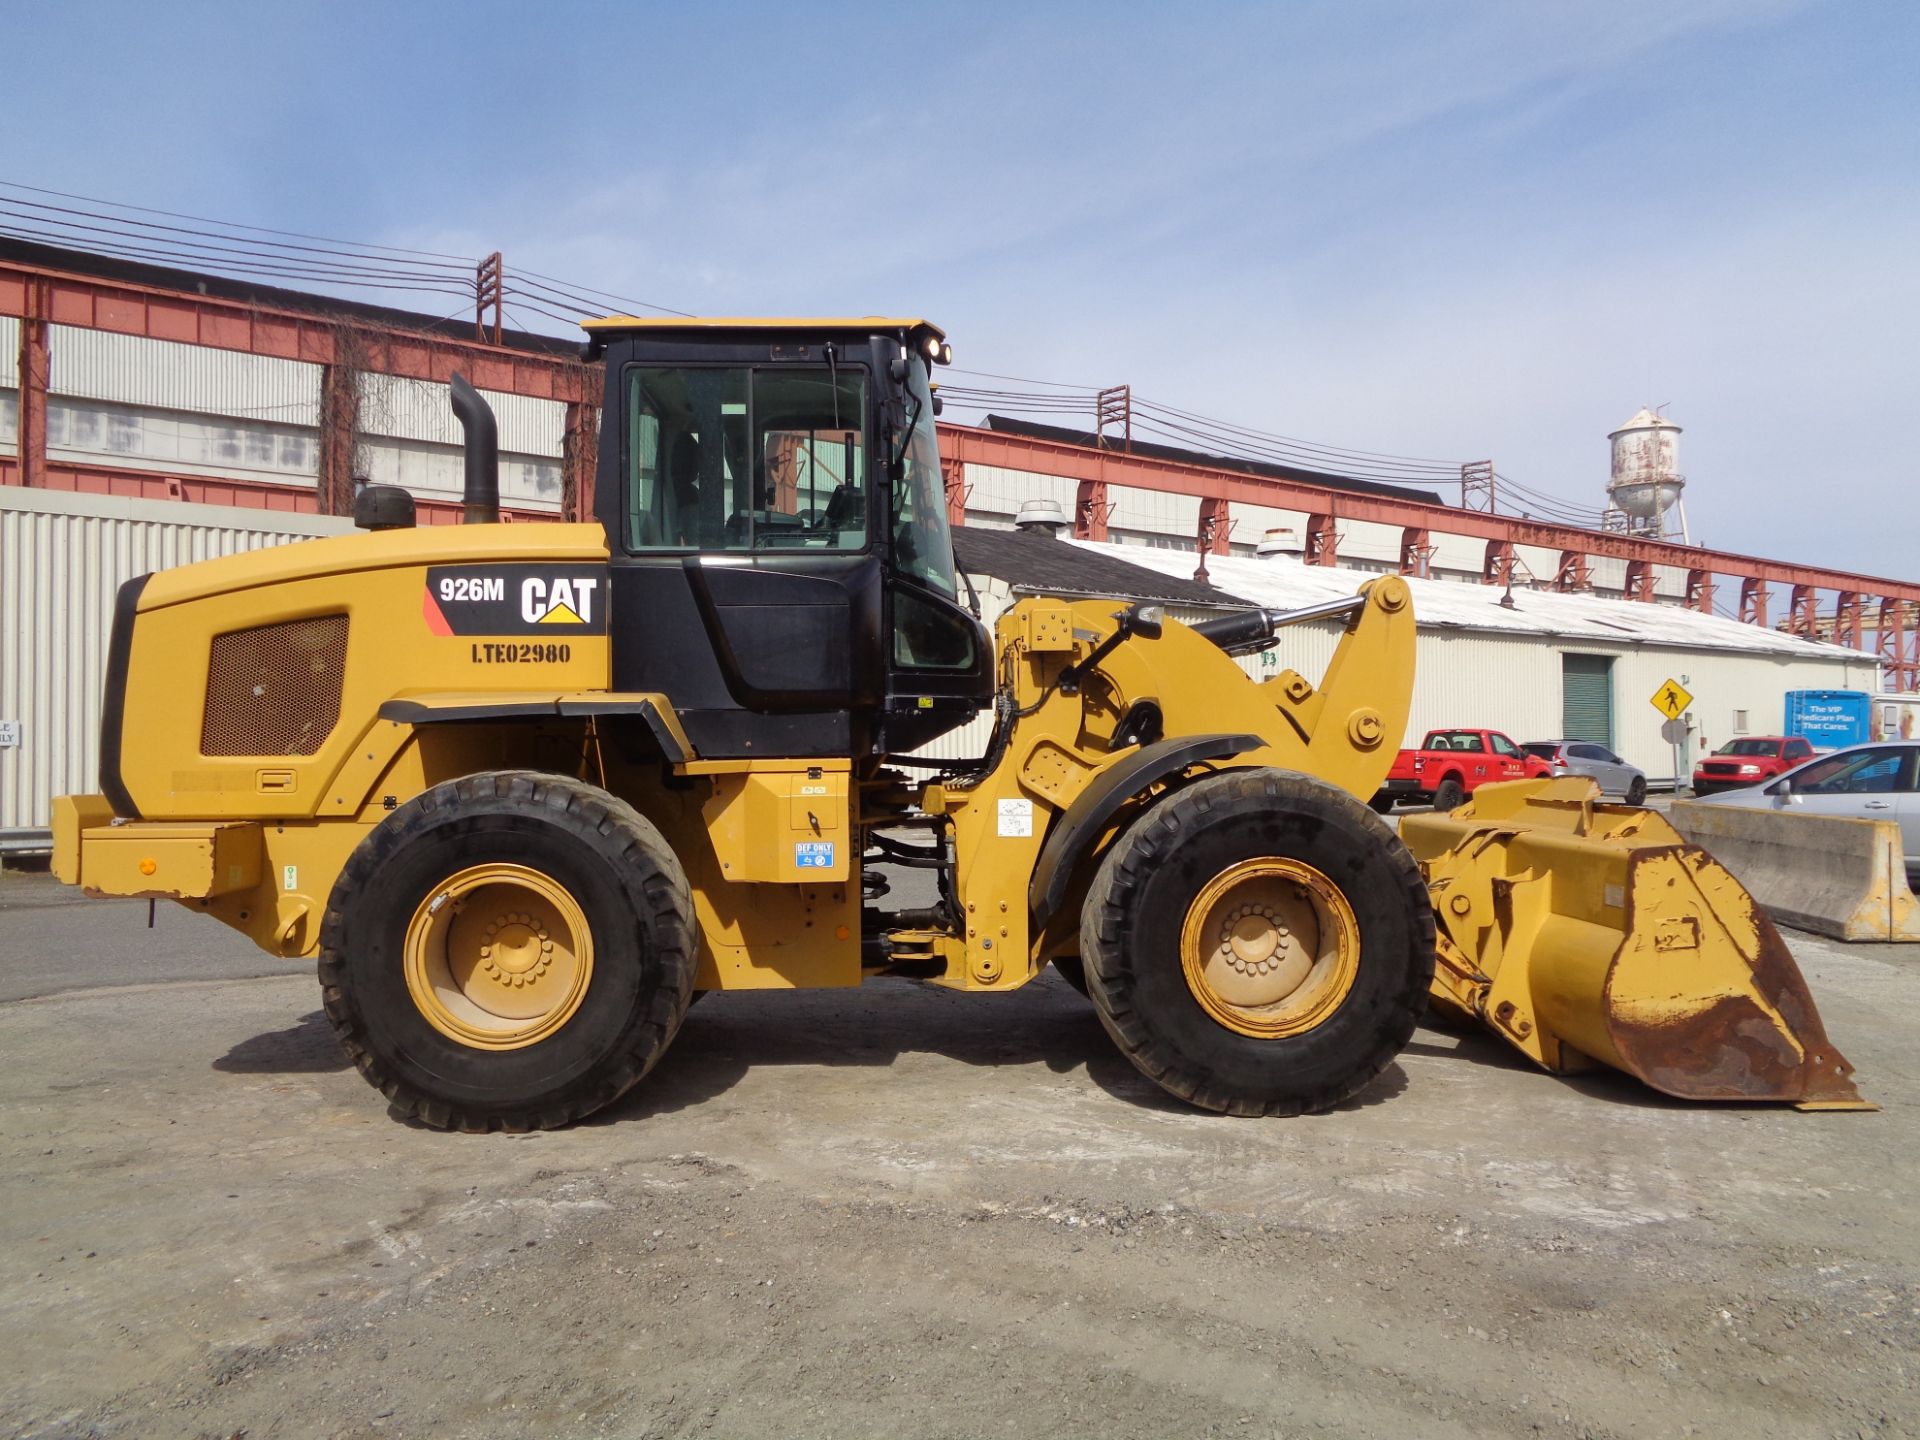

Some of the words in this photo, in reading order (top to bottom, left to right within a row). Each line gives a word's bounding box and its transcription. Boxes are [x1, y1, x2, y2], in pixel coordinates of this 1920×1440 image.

[440, 578, 504, 601] 926M
[521, 577, 597, 624] CAT
[472, 643, 571, 664] LTE02980
[1810, 705, 1826, 713] The
[1827, 705, 1842, 713] VIP
[1836, 714, 1855, 722] Plan
[1803, 722, 1822, 730] That
[1823, 722, 1850, 731] Cares.
[797, 843, 812, 852] DEF
[813, 843, 832, 852] ONLY
